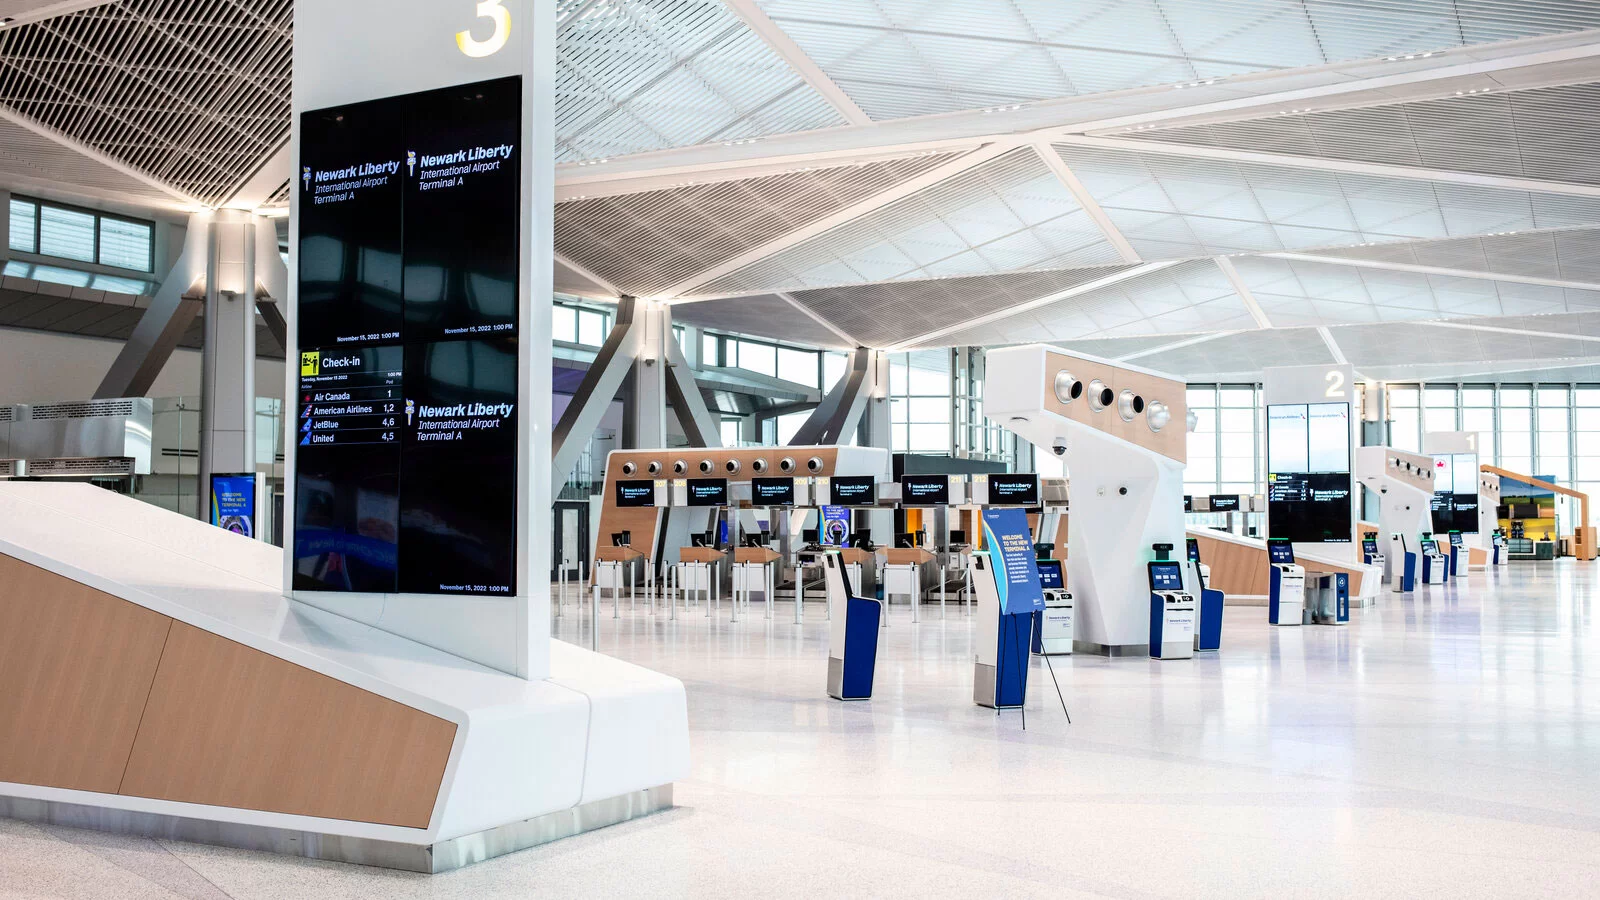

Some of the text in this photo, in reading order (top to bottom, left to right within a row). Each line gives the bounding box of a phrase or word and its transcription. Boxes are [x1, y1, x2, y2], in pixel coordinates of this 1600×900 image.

[456, 0, 512, 58] 3
[420, 144, 513, 168] Newark Liberty
[315, 160, 400, 182] Newark Liberty
[420, 160, 500, 180] International Airport
[315, 176, 388, 194] International Airport
[419, 177, 464, 191] Terminal A
[314, 191, 355, 205] Terminal A
[322, 356, 360, 368] Check-in
[1325, 371, 1345, 397] 2
[325, 392, 350, 400] Canada
[314, 406, 345, 415] American
[384, 404, 394, 413] 1,2
[419, 403, 514, 418] Newark Liberty
[313, 421, 338, 429] JetBlue
[382, 418, 394, 427] 4,6
[418, 419, 500, 430] International Airport
[382, 432, 394, 441] 4,5
[417, 431, 462, 441] Terminal A
[1466, 434, 1475, 450] 1
